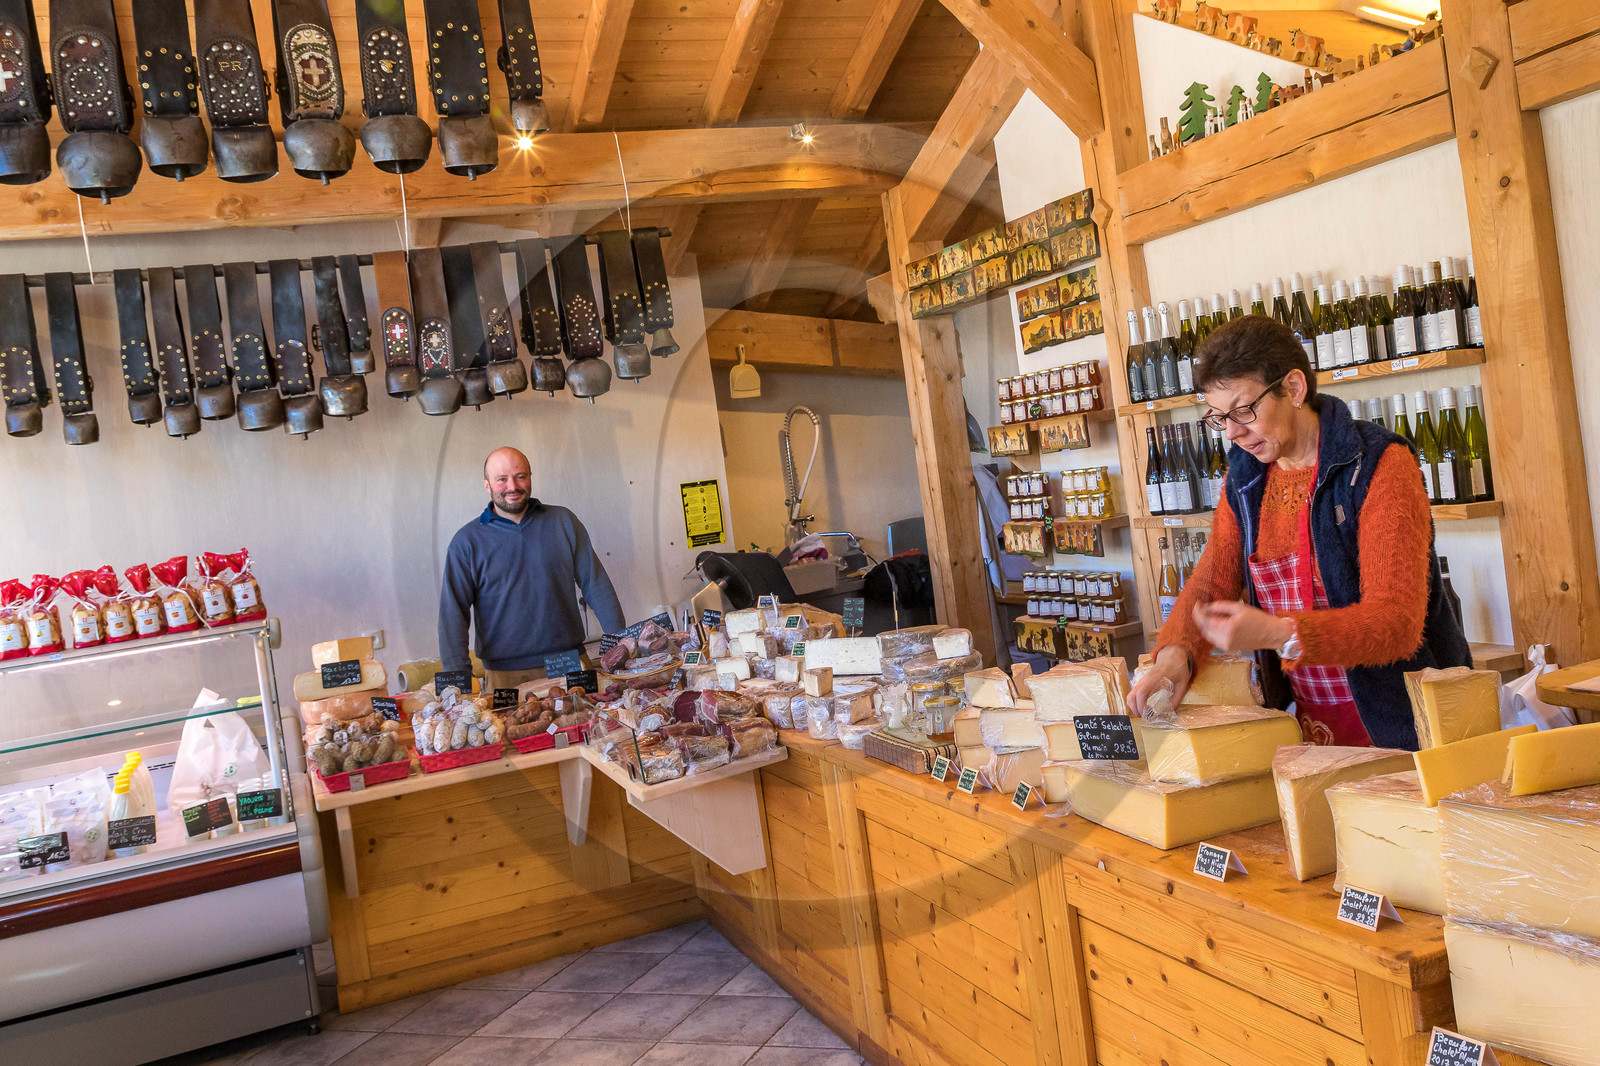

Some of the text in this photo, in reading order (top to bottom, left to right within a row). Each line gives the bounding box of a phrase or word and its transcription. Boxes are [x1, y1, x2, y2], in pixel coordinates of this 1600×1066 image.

[218, 60, 244, 71] PR
[1074, 716, 1098, 730] Comté
[1200, 845, 1224, 862] Fromage
[1345, 887, 1378, 903] Beaufort
[1433, 1042, 1461, 1058] Chalet
[1435, 1031, 1479, 1053] Beaufort
